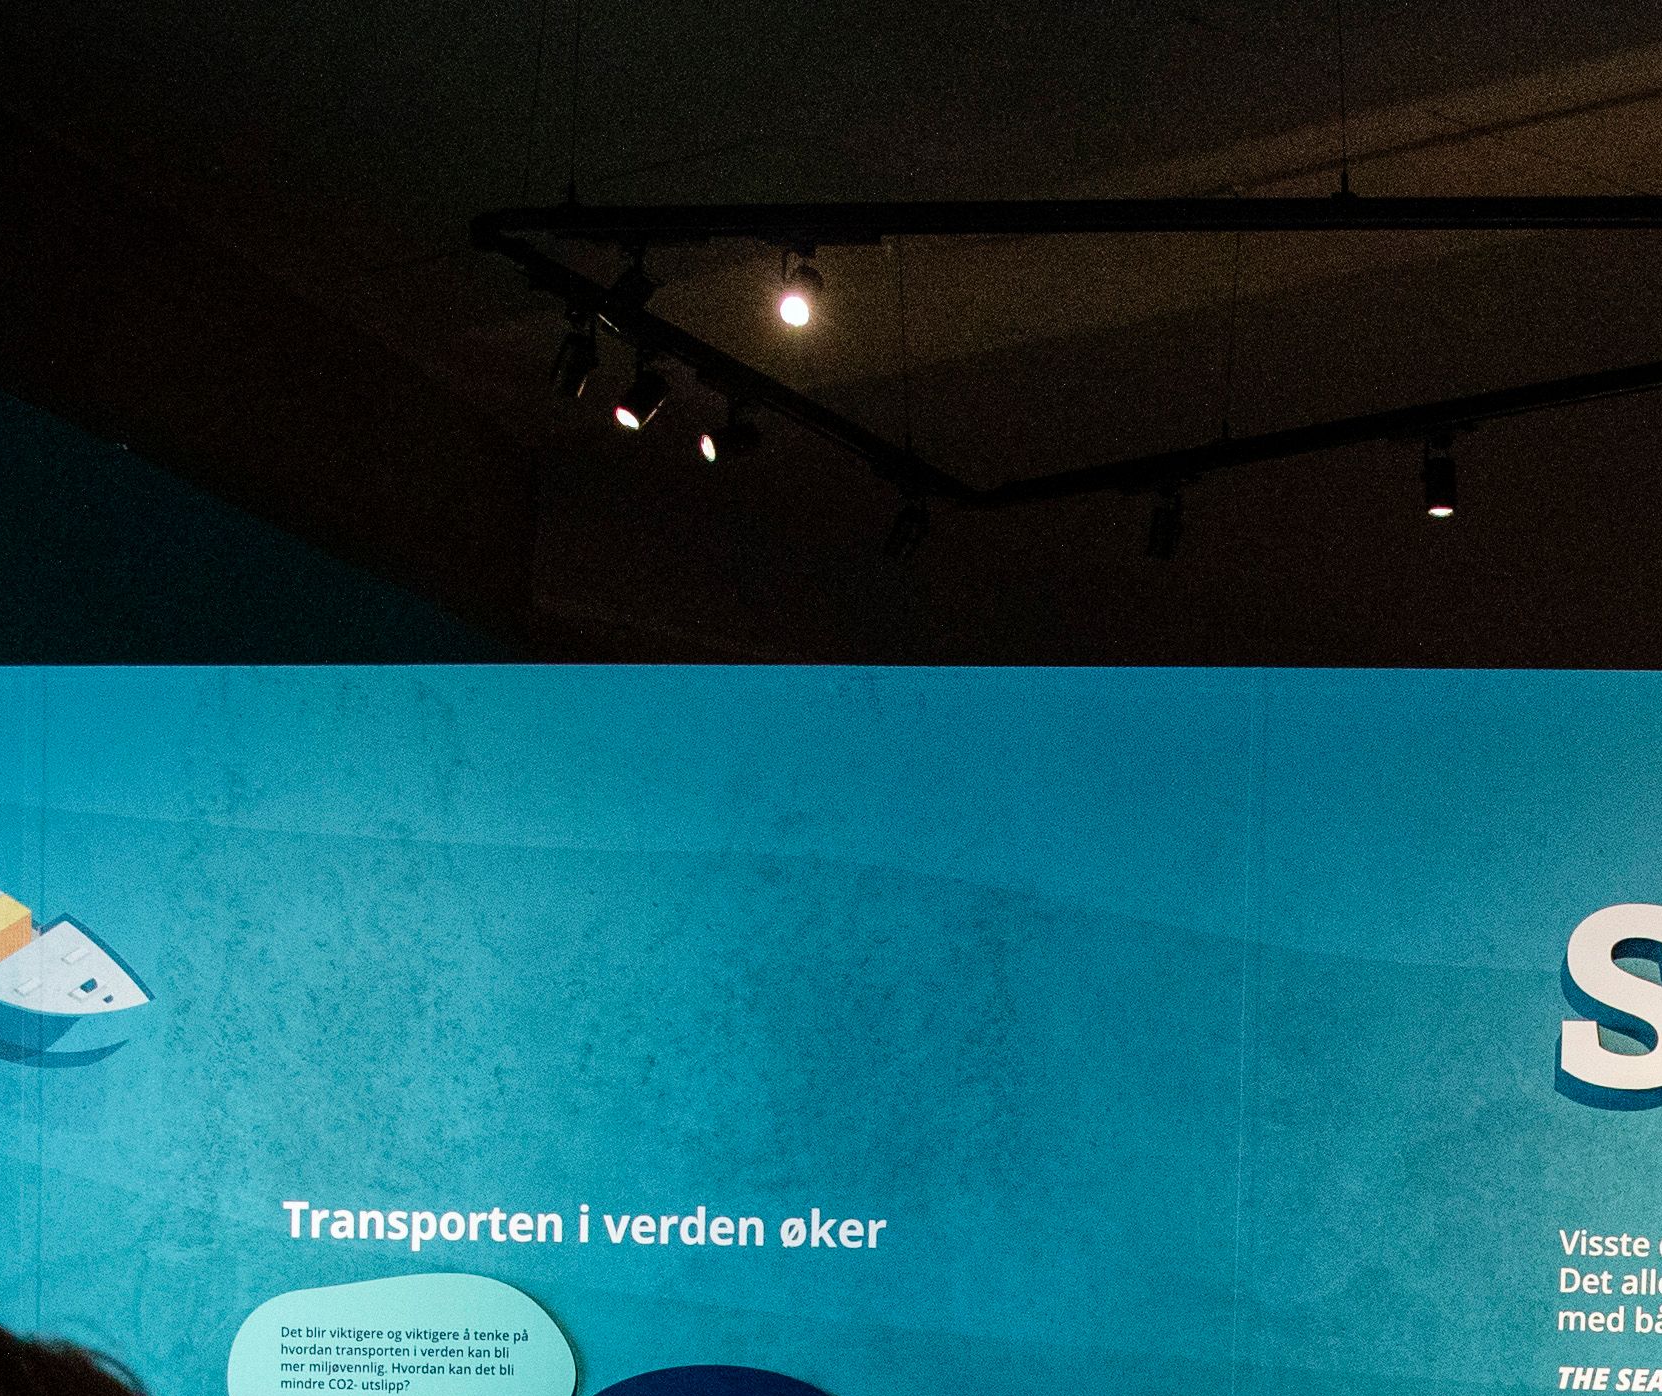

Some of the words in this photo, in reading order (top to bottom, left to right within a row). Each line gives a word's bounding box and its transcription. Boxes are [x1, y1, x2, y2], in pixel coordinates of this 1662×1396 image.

[281, 1198, 563, 1254] Transporten
[578, 1203, 590, 1244] i
[603, 1204, 765, 1247] verden
[779, 1207, 887, 1250] øker
[1559, 1229, 1651, 1259] Visste
[1559, 1266, 1613, 1296] Det
[1557, 1305, 1625, 1334] med
[280, 1326, 302, 1338] Det
[305, 1326, 326, 1338] blir
[329, 1326, 383, 1343] viktigere
[386, 1329, 402, 1343] og
[404, 1327, 459, 1344] viktigere
[462, 1326, 470, 1340] å
[473, 1329, 509, 1342] tenke
[512, 1327, 528, 1345] på
[280, 1342, 331, 1355] hvordan
[335, 1344, 409, 1359] transporten
[413, 1345, 416, 1357] i
[420, 1344, 463, 1358] verden
[467, 1345, 490, 1358] kan
[494, 1345, 509, 1358] bli
[280, 1362, 305, 1372] mer
[308, 1360, 387, 1376] miljøvennlig.
[391, 1361, 444, 1375] Hvordan
[448, 1362, 471, 1375] kan
[474, 1362, 495, 1376] det
[498, 1362, 514, 1376] bli
[1557, 1365, 1612, 1391] THE
[280, 1377, 324, 1389] mindre
[361, 1378, 410, 1394] utslipp?
